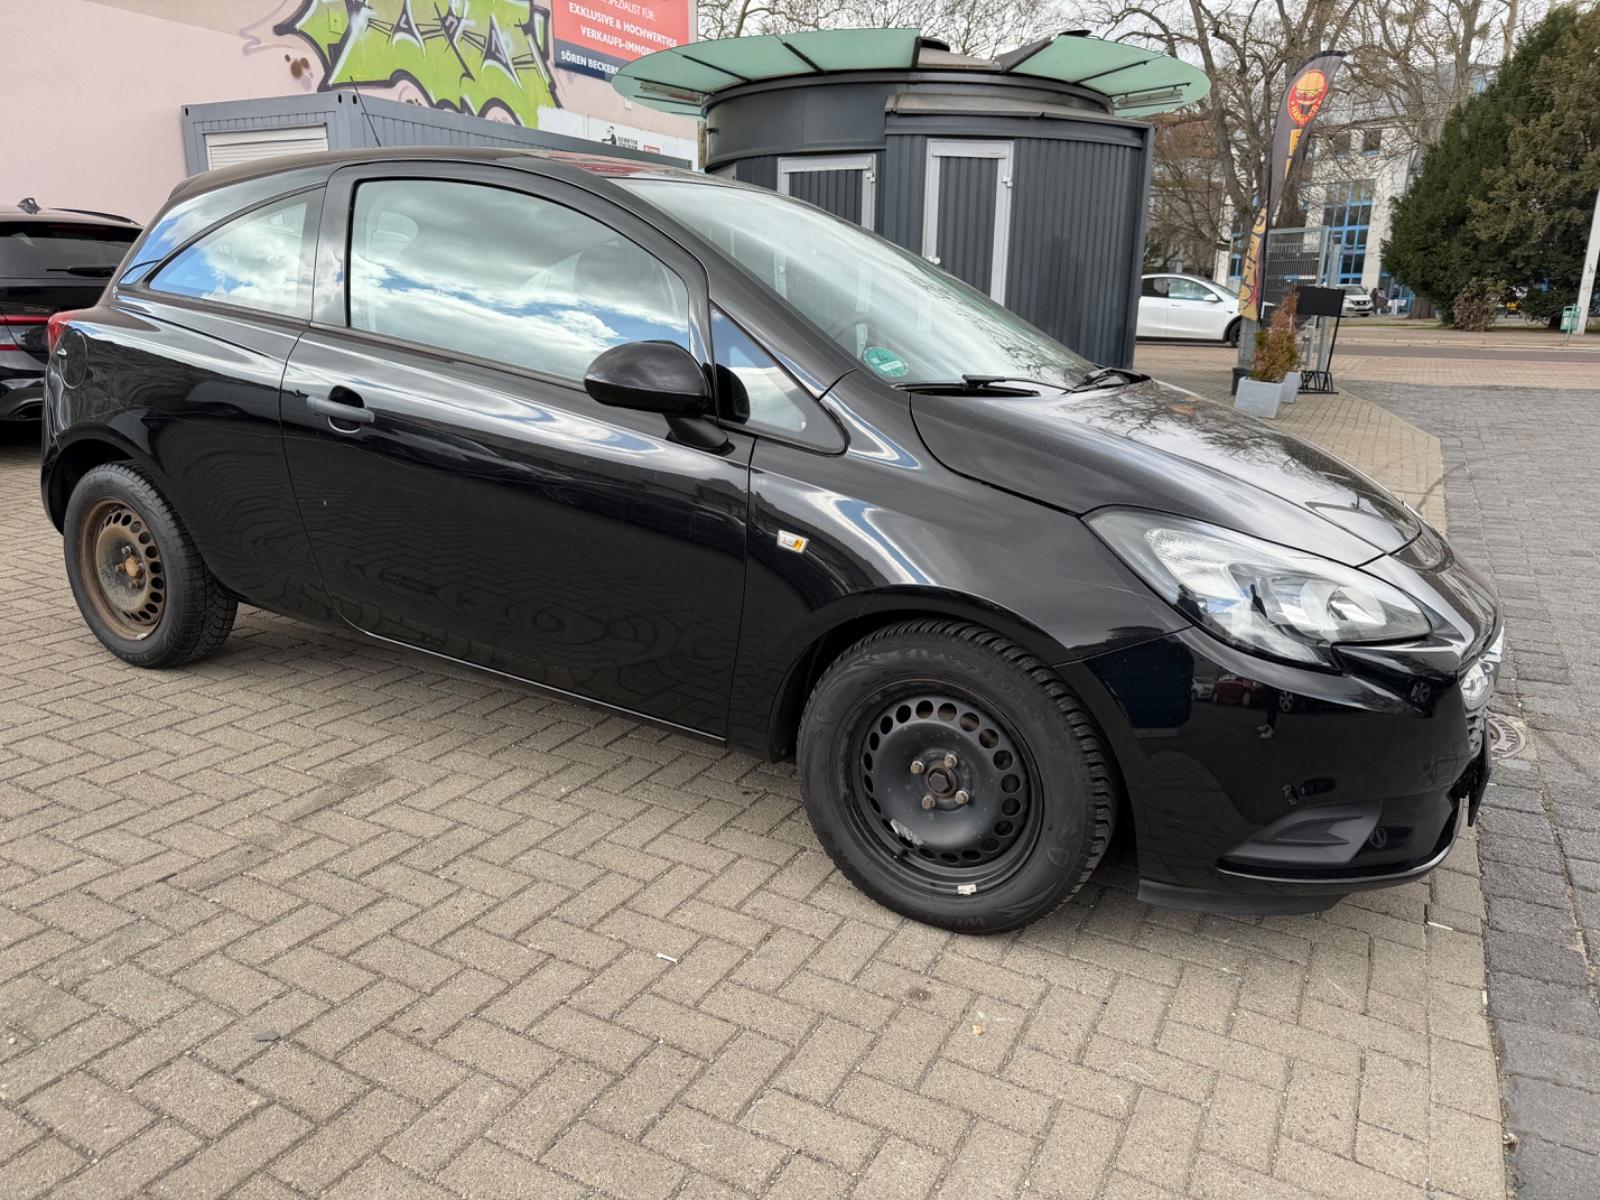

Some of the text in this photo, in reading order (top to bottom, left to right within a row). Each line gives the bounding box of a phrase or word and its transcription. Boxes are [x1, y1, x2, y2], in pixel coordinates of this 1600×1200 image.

[602, 0, 640, 15] PEZIALIST
[568, 2, 677, 47] EXKLUSIVE & HOCHWERTIGE
[580, 26, 656, 56] VERKAUFS-IMMOB
[561, 50, 587, 67] SÖREN
